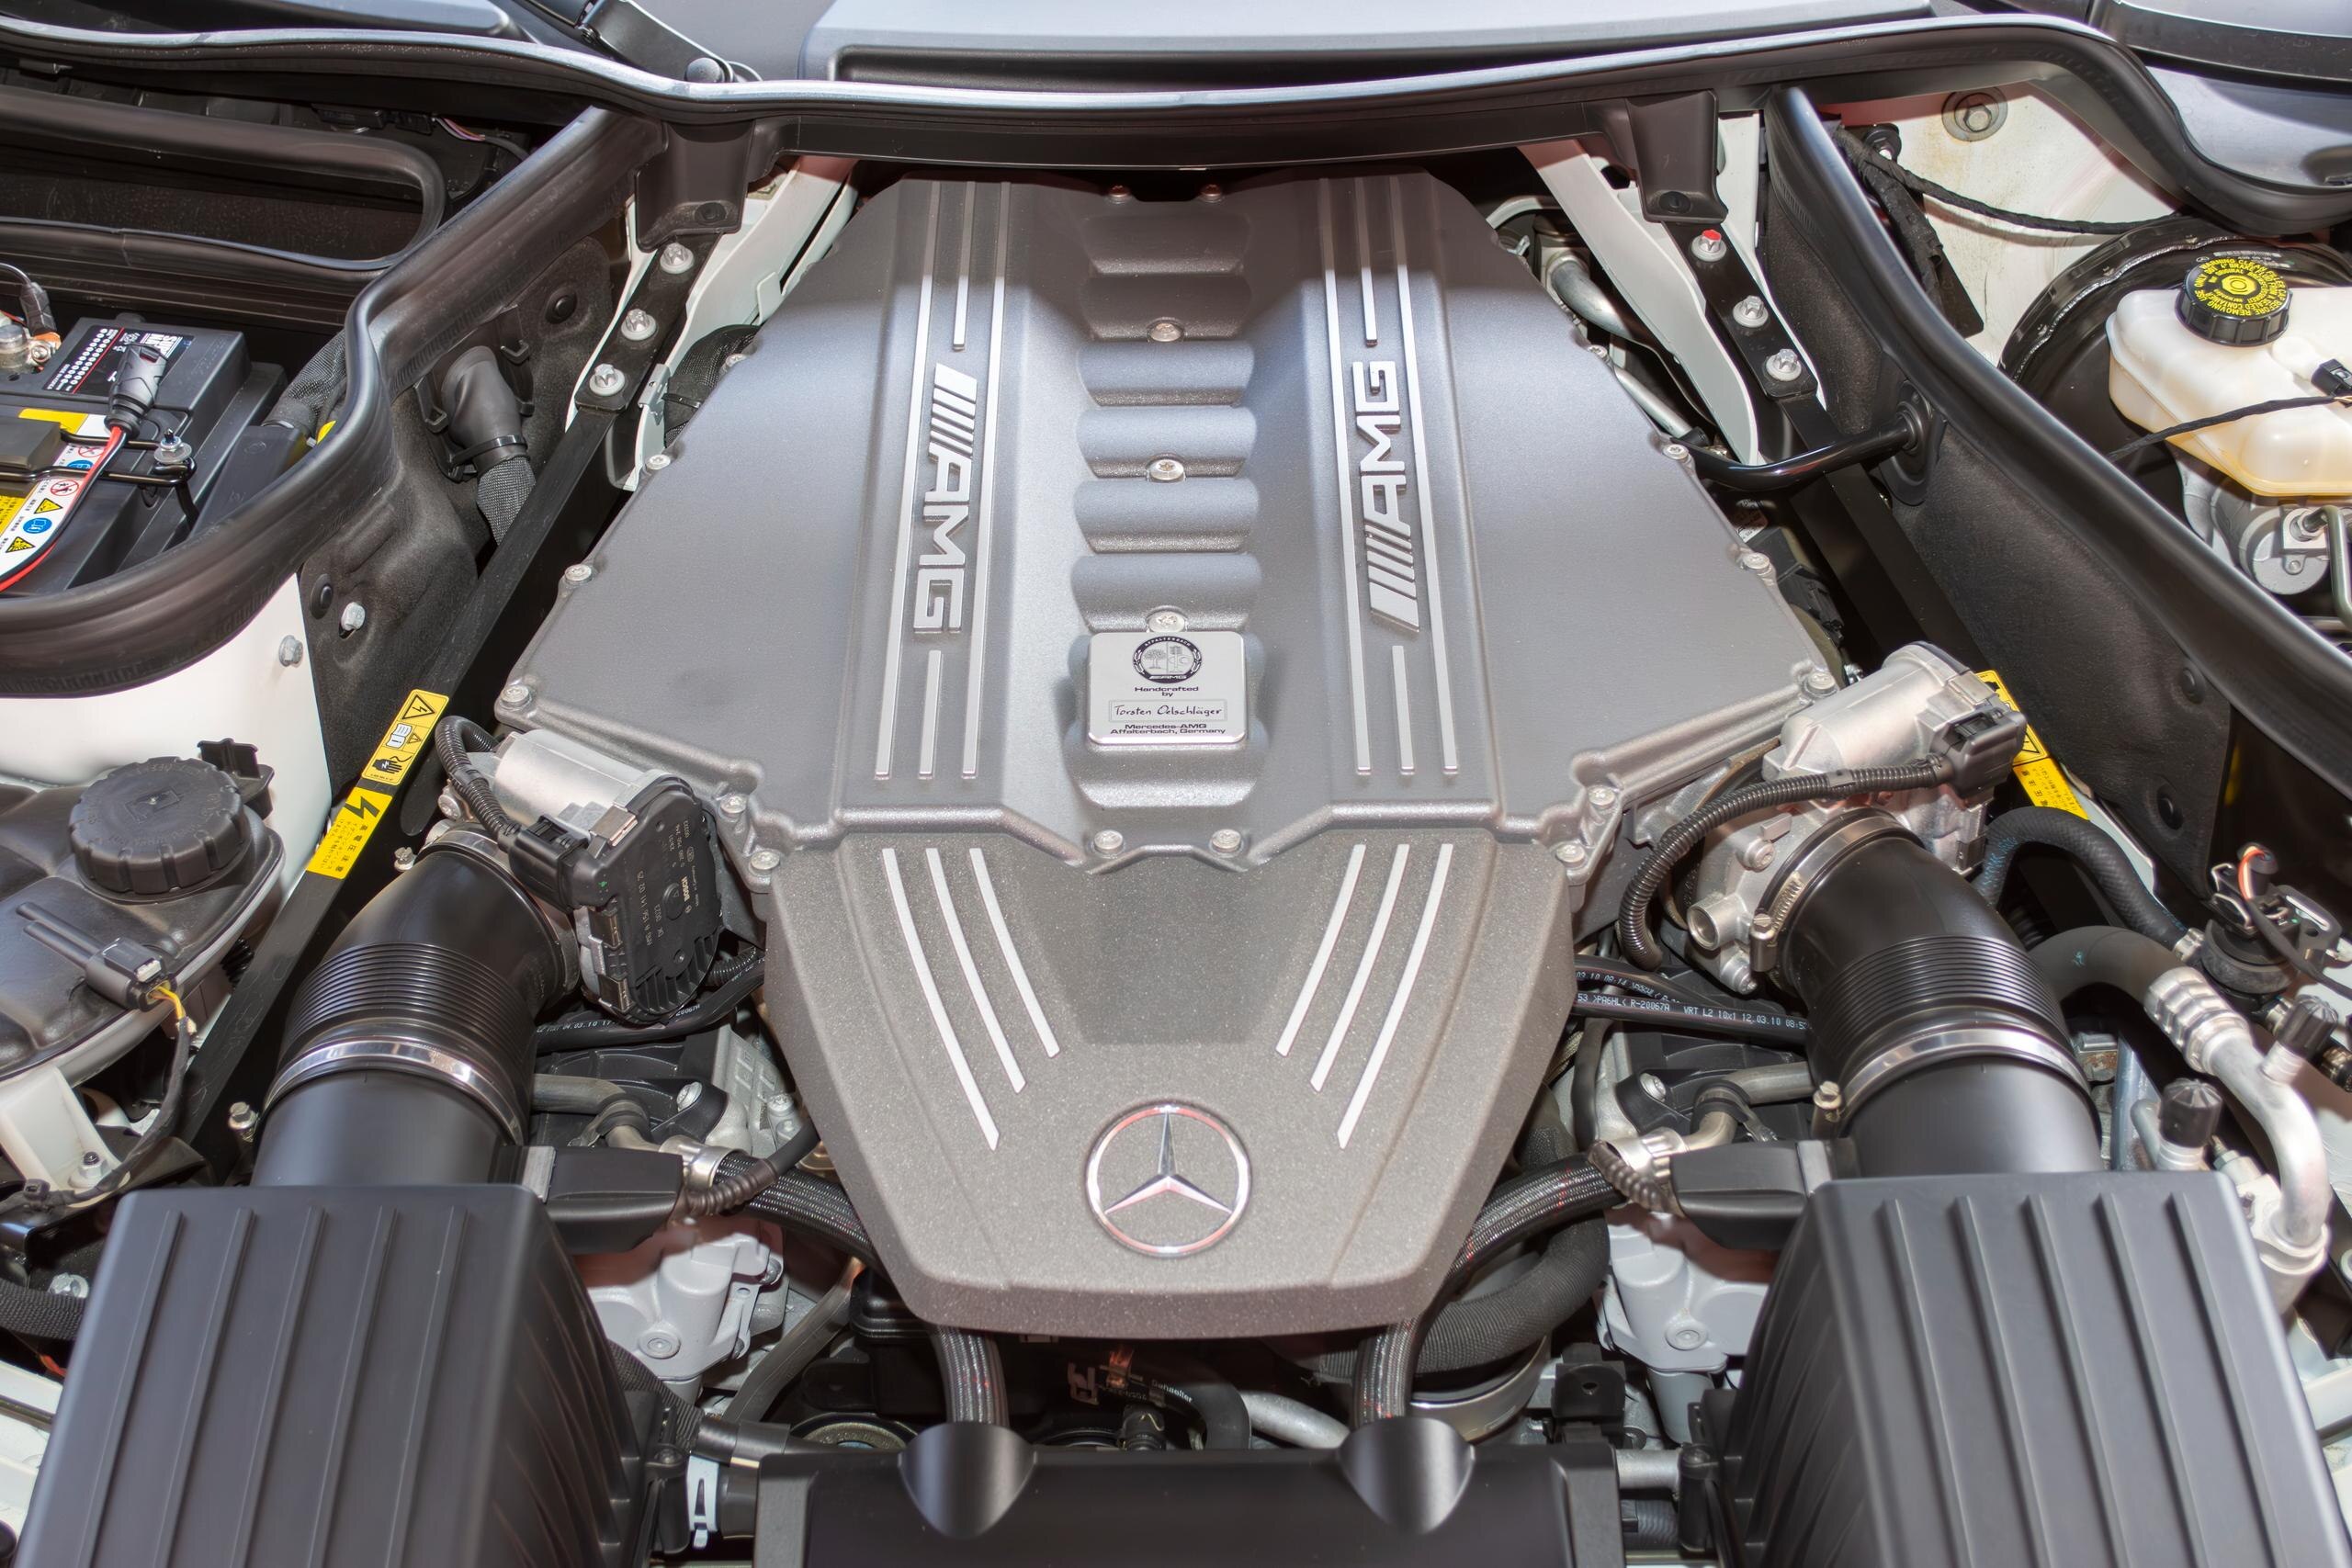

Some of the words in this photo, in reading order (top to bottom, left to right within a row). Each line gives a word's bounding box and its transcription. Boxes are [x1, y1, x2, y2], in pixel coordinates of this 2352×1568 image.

[2239, 259, 2267, 272] CLEAN
[2229, 263, 2254, 272] BRAKE
[2245, 299, 2272, 310] SEALED
[2207, 300, 2252, 316] REMOVING
[2255, 299, 2282, 315] BEFORE
[1114, 704, 1151, 716] Torsten
[681, 875, 691, 903] BOSCH
[1630, 998, 1670, 1011] R-20067A
[1683, 1006, 1699, 1015] VRT
[1702, 1009, 1713, 1018] L2
[1718, 1010, 1736, 1021] 10x1
[1742, 1013, 1781, 1026] 12.03.10
